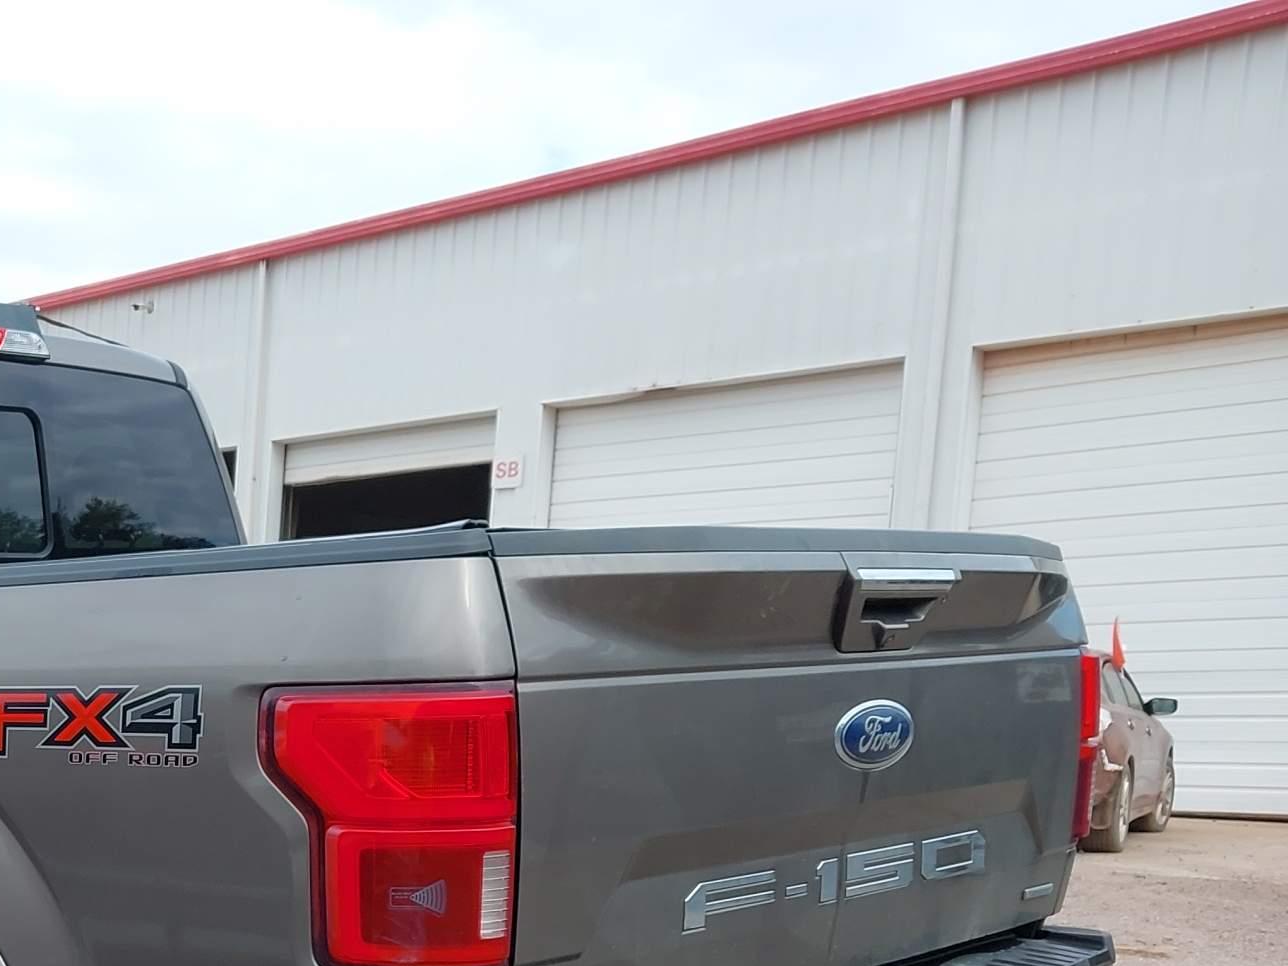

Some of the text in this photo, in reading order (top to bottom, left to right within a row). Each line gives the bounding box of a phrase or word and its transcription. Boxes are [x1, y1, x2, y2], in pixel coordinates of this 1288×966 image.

[495, 461, 519, 479] SB
[858, 715, 902, 753] Ford
[68, 751, 199, 768] OFF ROAD
[682, 829, 986, 934] F-150
